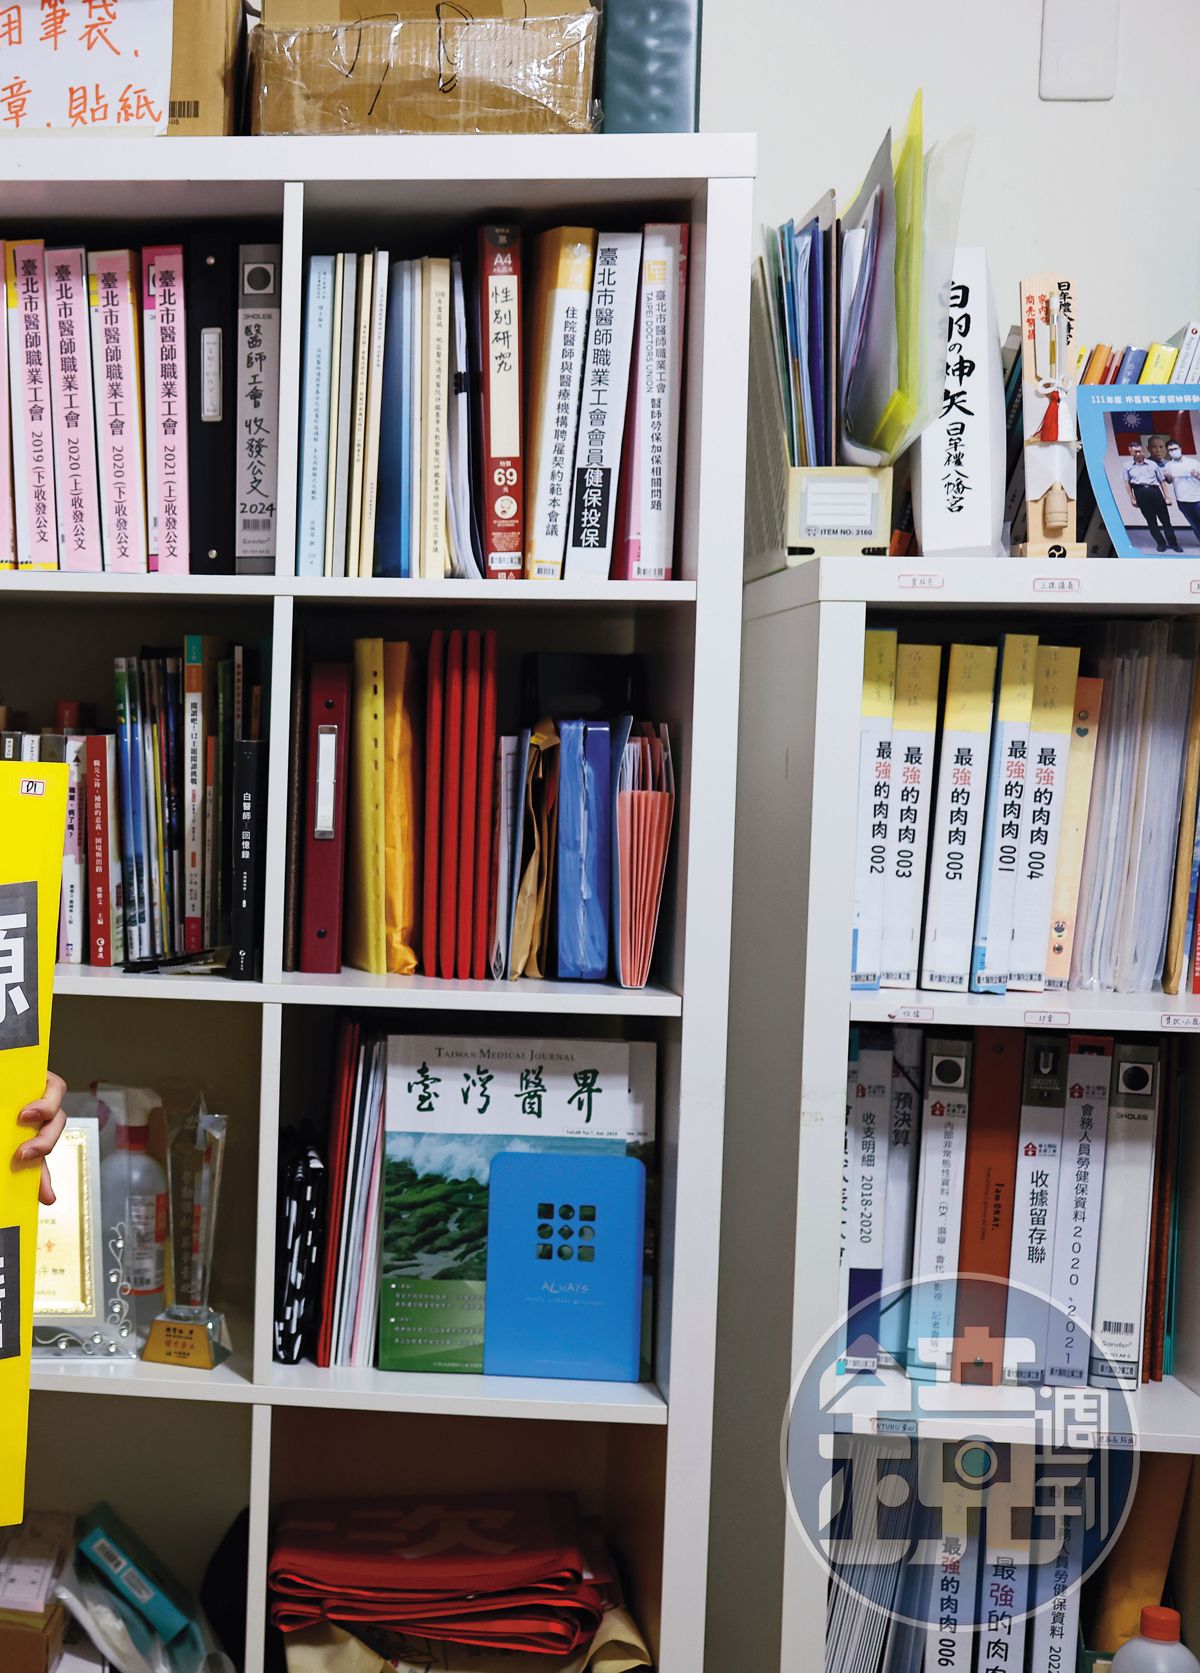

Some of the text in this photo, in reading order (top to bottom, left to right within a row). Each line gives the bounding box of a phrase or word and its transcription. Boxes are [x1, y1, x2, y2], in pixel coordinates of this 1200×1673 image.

[494, 254, 512, 266] A4
[21, 259, 44, 422] 臺北市醫師職業工會
[55, 264, 80, 428] 臺北市醫師職業工會
[102, 271, 125, 435] 臺北市醫師職業工會
[159, 270, 178, 435] 臺北市醫師職業工會
[650, 290, 666, 510] 臺北市醫師職業工會 醫師勞保加保相關問題
[240, 502, 276, 518] 2024
[493, 468, 518, 487] 69
[870, 740, 892, 875] 最強的肉肉 002
[895, 746, 924, 878] 最強的肉肉 003
[945, 747, 973, 881] 最強的肉肉 005
[998, 740, 1028, 872] 最強的肉肉 001
[1027, 748, 1057, 881] 最強的肉肉 004
[407, 1062, 603, 1123] 臺灣醫界
[435, 1047, 576, 1062] TAIWAN MEDICAL JOURNAL
[892, 1093, 914, 1147] 預決算
[859, 1113, 876, 1244] 收支明細 2018-2020
[1027, 1170, 1049, 1264] 收據留存聯
[938, 1537, 962, 1667] 最強的肉肉 006
[1049, 1647, 1061, 1673] 202
